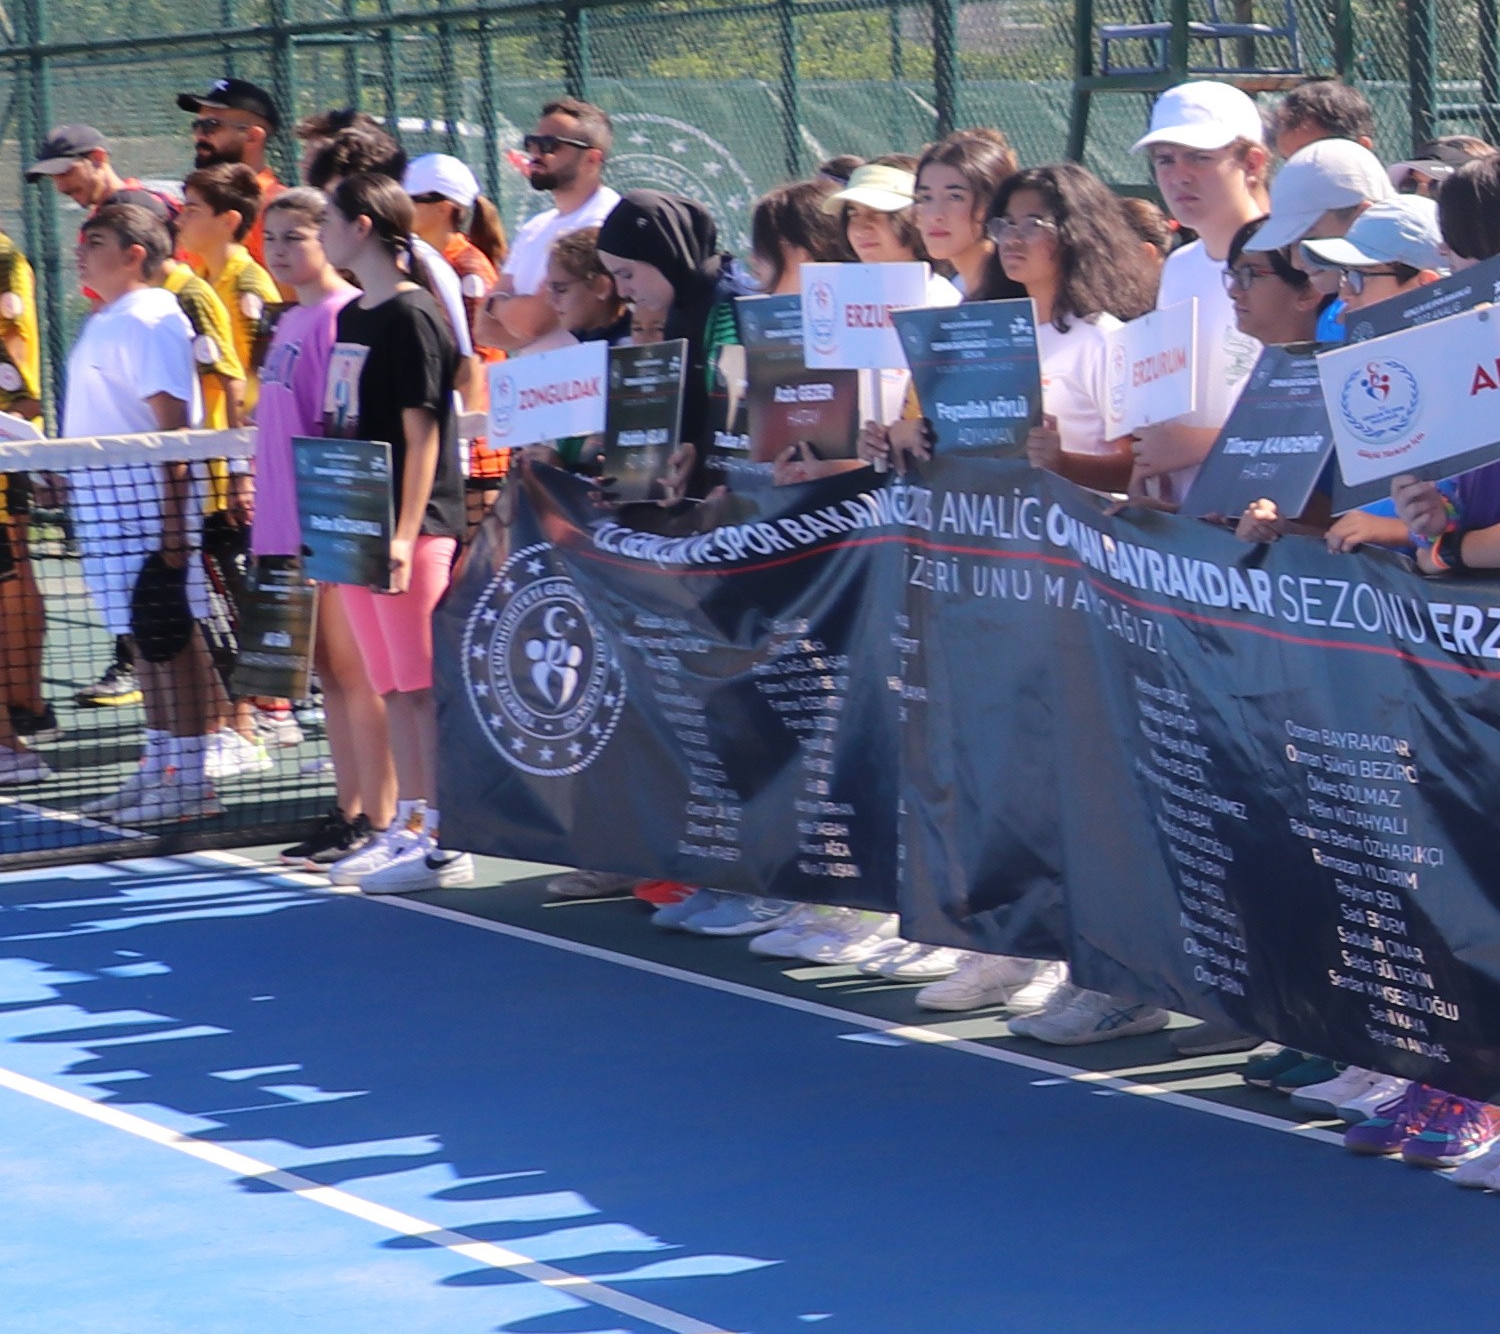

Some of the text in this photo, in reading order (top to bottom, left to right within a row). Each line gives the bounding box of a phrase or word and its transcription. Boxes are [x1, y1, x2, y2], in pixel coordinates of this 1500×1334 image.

[845, 304, 894, 328] ERZUR
[1132, 347, 1187, 387] ERZURUM
[519, 377, 601, 410] ZONGULDAK
[714, 522, 795, 561] SPOR
[938, 488, 1042, 541] ANALİG
[1046, 502, 1106, 573] OMAN
[1102, 534, 1275, 618] BAYRAKDAR
[1279, 574, 1426, 644] SEZONU
[1322, 729, 1411, 758] BAYRAKDAR
[1339, 783, 1402, 808] SOLMAZ
